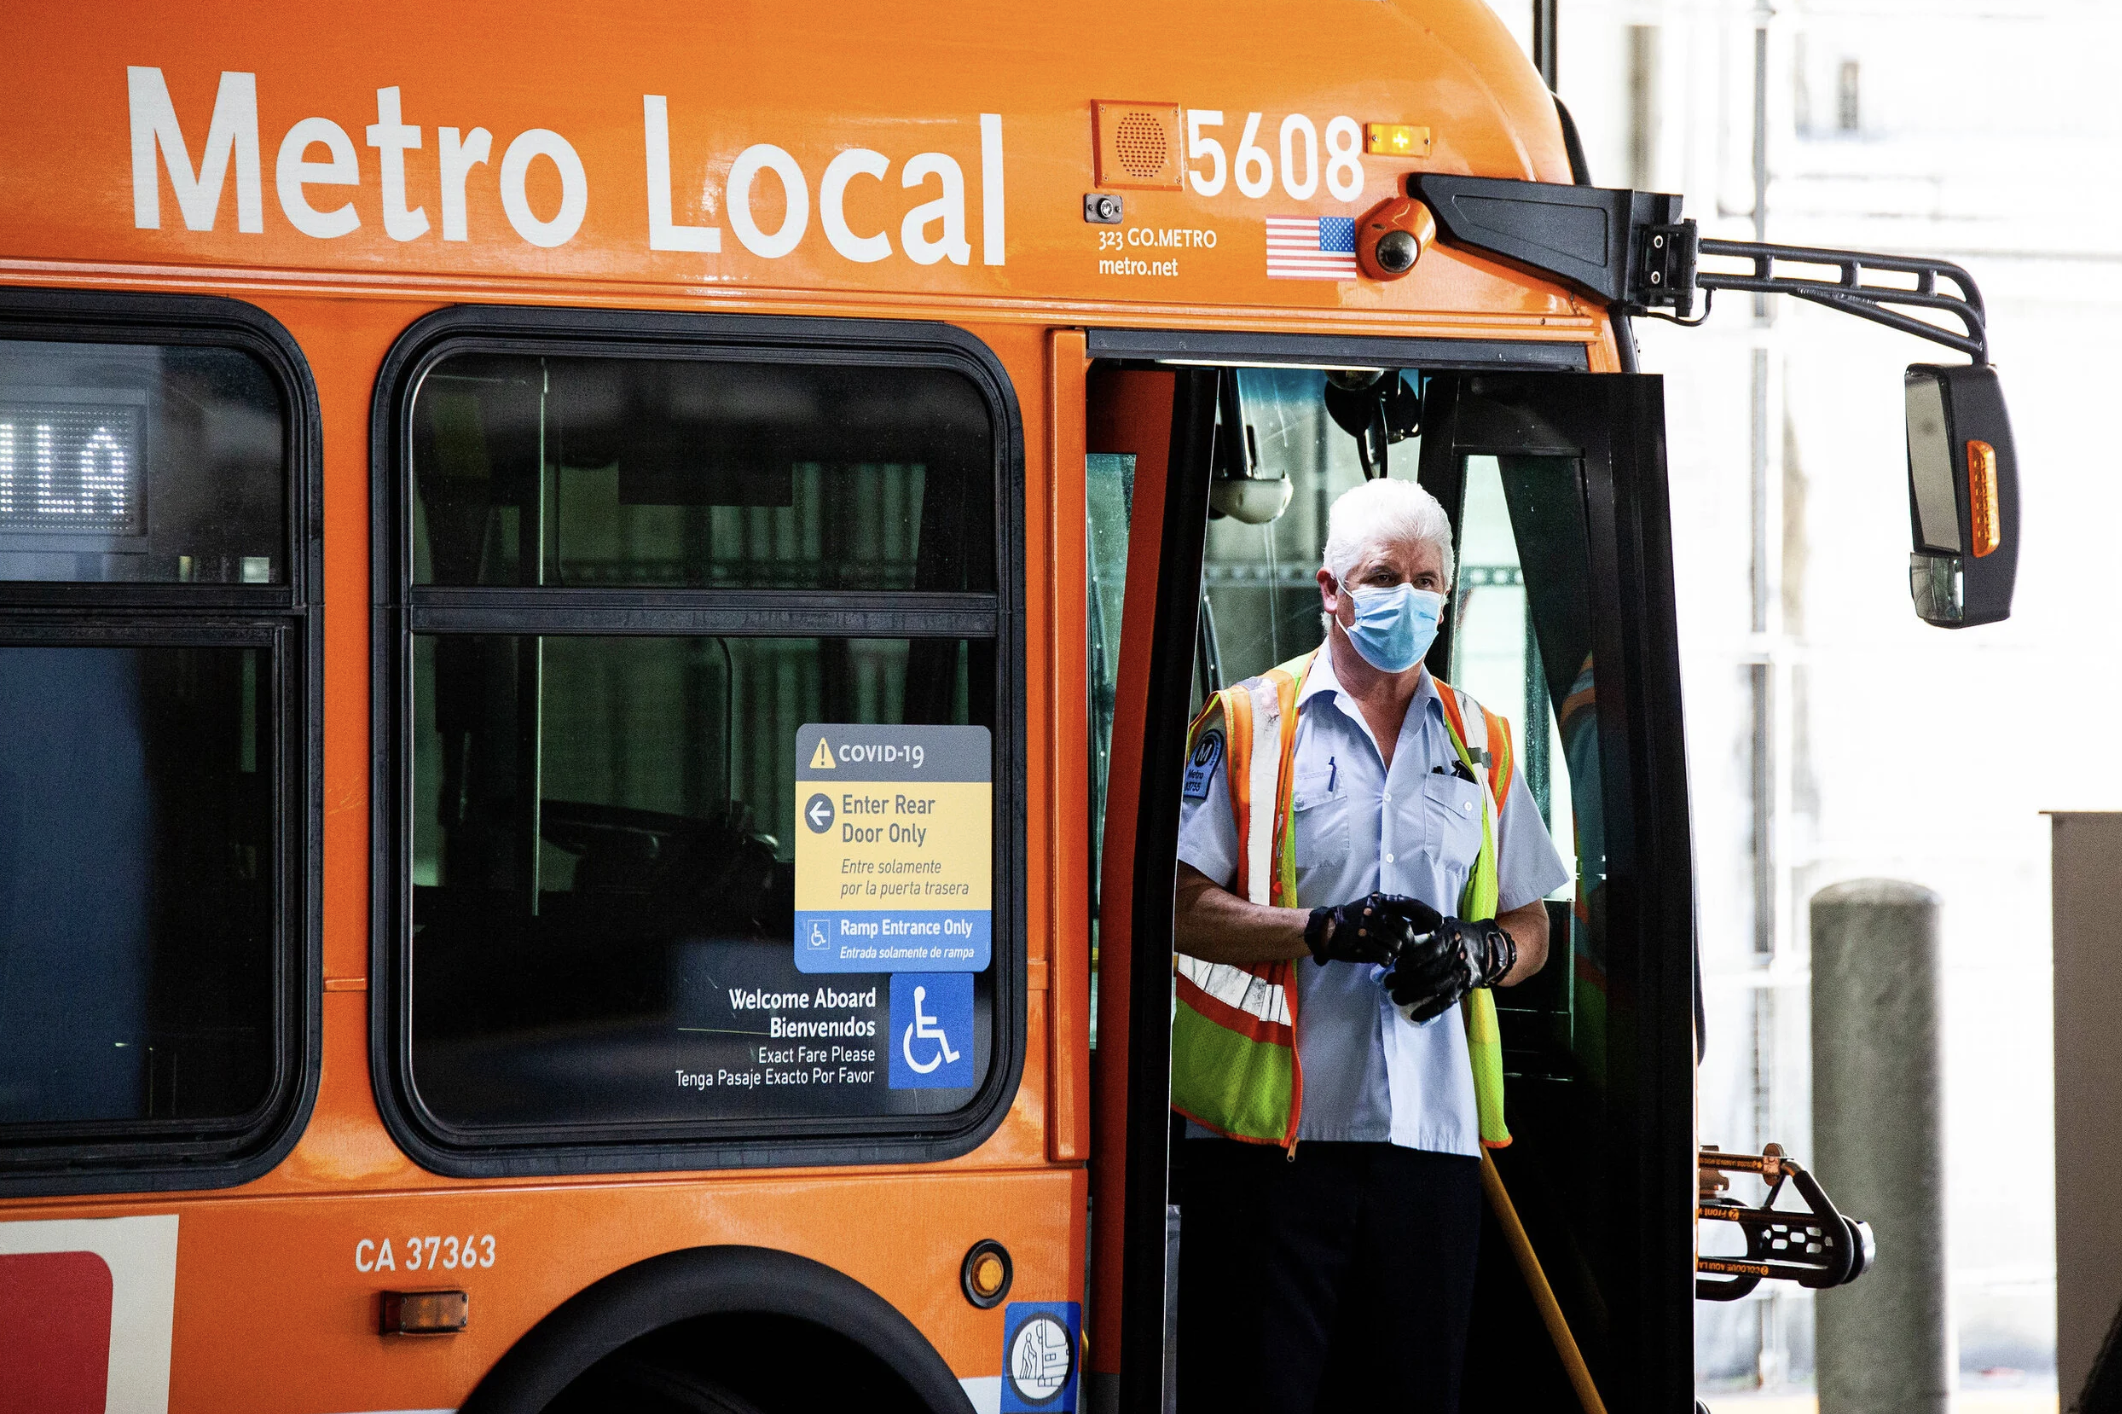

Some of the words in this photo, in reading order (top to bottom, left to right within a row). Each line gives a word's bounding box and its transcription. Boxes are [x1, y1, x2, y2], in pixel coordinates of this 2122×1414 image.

[127, 66, 588, 248] Metro
[644, 95, 1005, 265] Local
[1187, 110, 1365, 203] 5608
[1099, 231, 1123, 250] 323
[1128, 228, 1216, 248] GO.METRO
[1099, 257, 1178, 276] metro.net
[839, 745, 924, 768] COVID-19
[1188, 769, 1204, 779] Metro
[843, 794, 889, 814] Enter
[896, 795, 935, 814] Rear
[843, 823, 883, 842] Door
[889, 823, 926, 847] Only
[842, 859, 874, 873] Entre
[878, 859, 941, 873] solamente
[841, 884, 862, 899] por
[866, 880, 876, 895] la
[880, 882, 920, 899] puerta
[925, 881, 969, 895] trasera
[841, 919, 878, 938] Ramp
[883, 919, 940, 935] Entrance
[944, 919, 972, 938] Only
[840, 946, 877, 958] Entrada
[879, 946, 928, 958] solamente
[930, 946, 941, 958] de
[944, 948, 974, 961] rampa
[729, 989, 809, 1009] Welcome
[814, 987, 875, 1008] Aboard
[771, 1016, 875, 1037] Bienvenidos
[759, 1047, 793, 1063] Exact
[799, 1046, 827, 1062] Fare
[832, 1046, 875, 1061] Please
[676, 1070, 713, 1090] Tenga
[718, 1069, 761, 1089] Pasaje
[766, 1068, 808, 1084] Exacto
[813, 1068, 835, 1083] Por
[839, 1067, 874, 1083] Favor
[356, 1238, 395, 1272] CA
[406, 1235, 495, 1270] 37363
